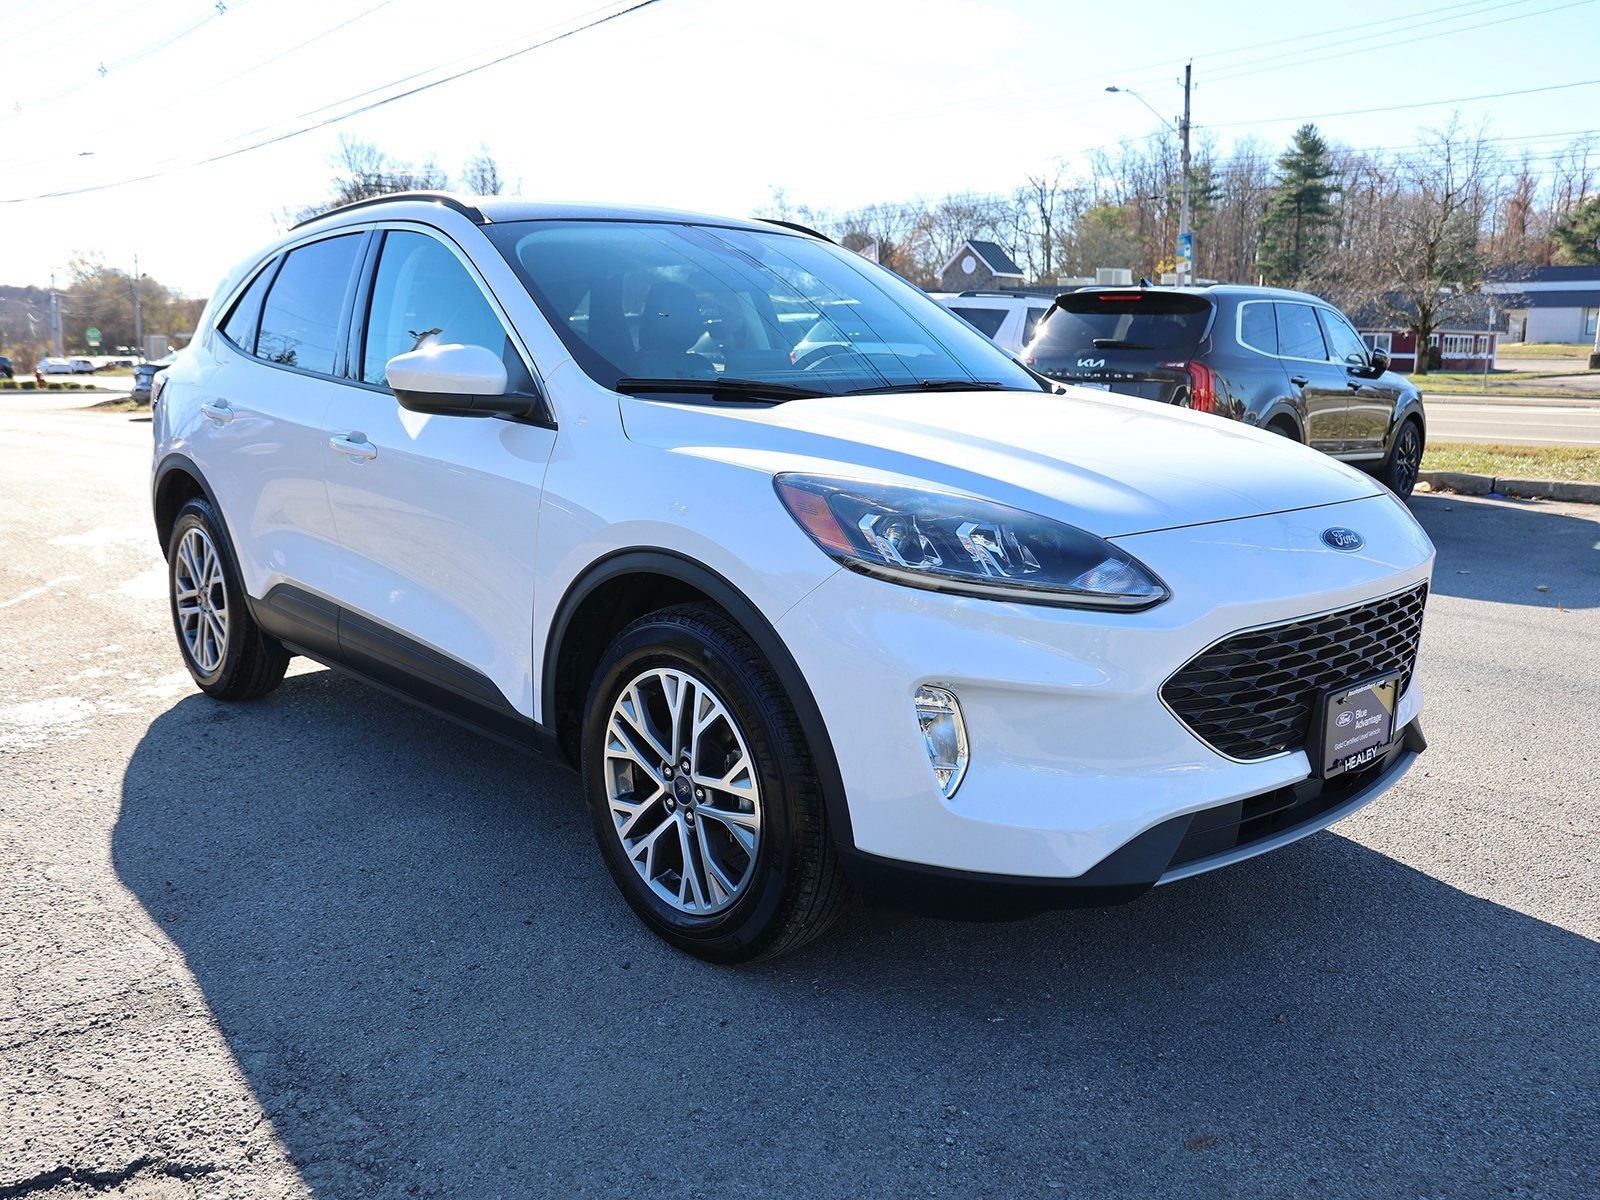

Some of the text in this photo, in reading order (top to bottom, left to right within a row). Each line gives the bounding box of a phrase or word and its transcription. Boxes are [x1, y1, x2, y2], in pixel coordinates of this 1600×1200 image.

[1331, 529, 1358, 546] Ford
[1354, 713, 1383, 730] Advantage
[1355, 709, 1368, 719] Blue
[1344, 745, 1378, 771] HEALEY
